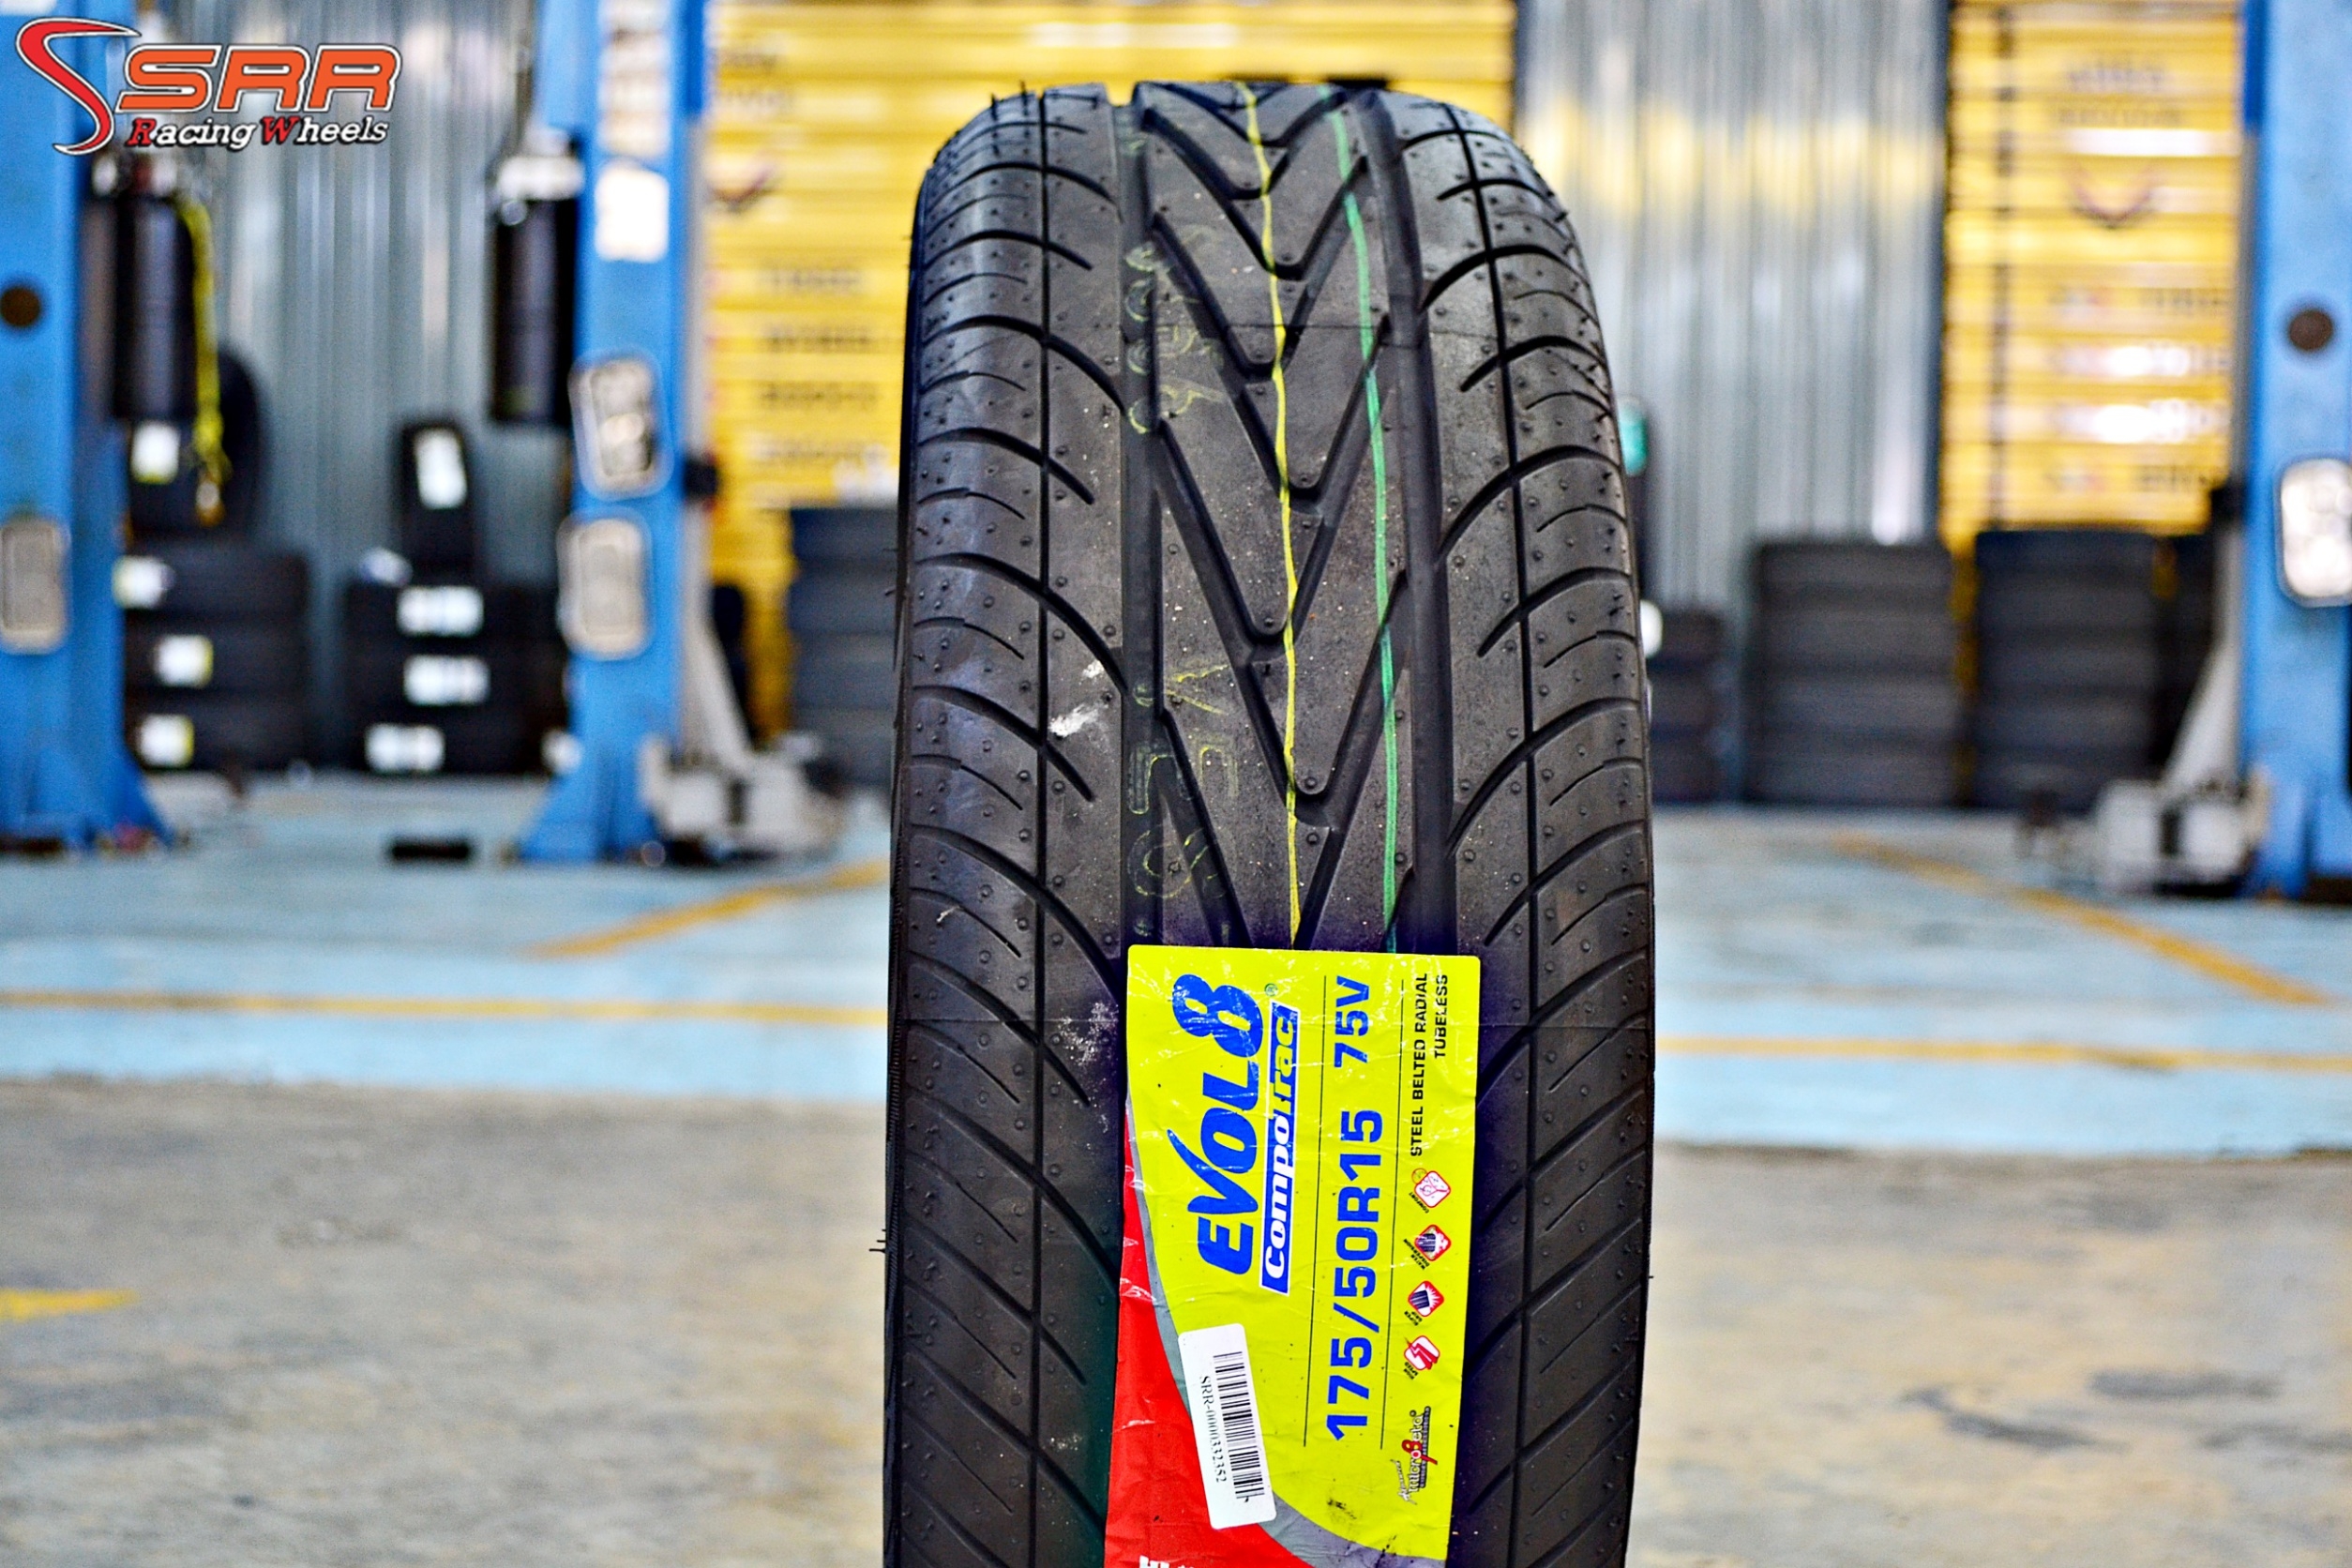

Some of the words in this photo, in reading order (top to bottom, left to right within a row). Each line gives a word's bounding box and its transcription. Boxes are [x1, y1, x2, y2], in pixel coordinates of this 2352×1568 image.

[1334, 975, 1369, 1067] 75V
[1415, 973, 1427, 1033] RADIAL
[1435, 974, 1448, 1059] TUBELESS
[1412, 1039, 1426, 1100] BELTED
[1410, 1107, 1424, 1156] STEEL
[1409, 1192, 1429, 1214] COMFORT
[1326, 1109, 1383, 1440] 175/50R15
[1403, 1239, 1430, 1267] DISPERSION
[1410, 1254, 1425, 1270] WATER
[1199, 1375, 1227, 1484] SRR-0000332352
